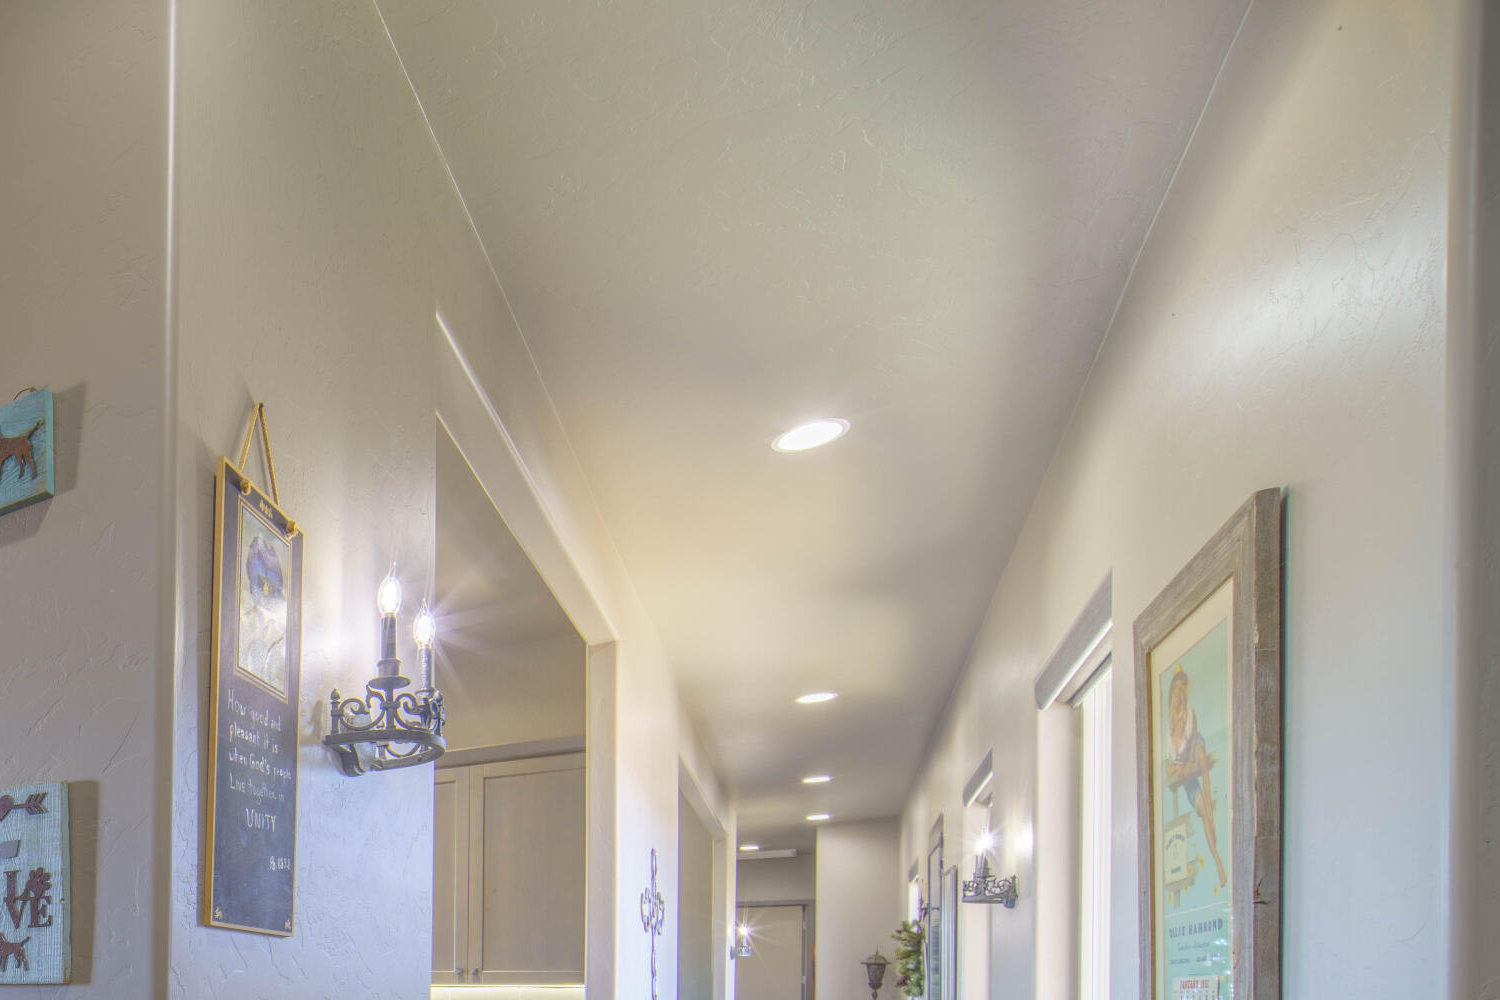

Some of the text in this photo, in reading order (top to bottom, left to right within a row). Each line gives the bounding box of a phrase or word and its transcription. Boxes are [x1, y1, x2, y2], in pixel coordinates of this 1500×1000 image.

[228, 687, 246, 716] How
[229, 720, 260, 745] pleasant
[229, 747, 248, 767] when
[249, 752, 271, 776] God's
[245, 807, 277, 833] UNITY
